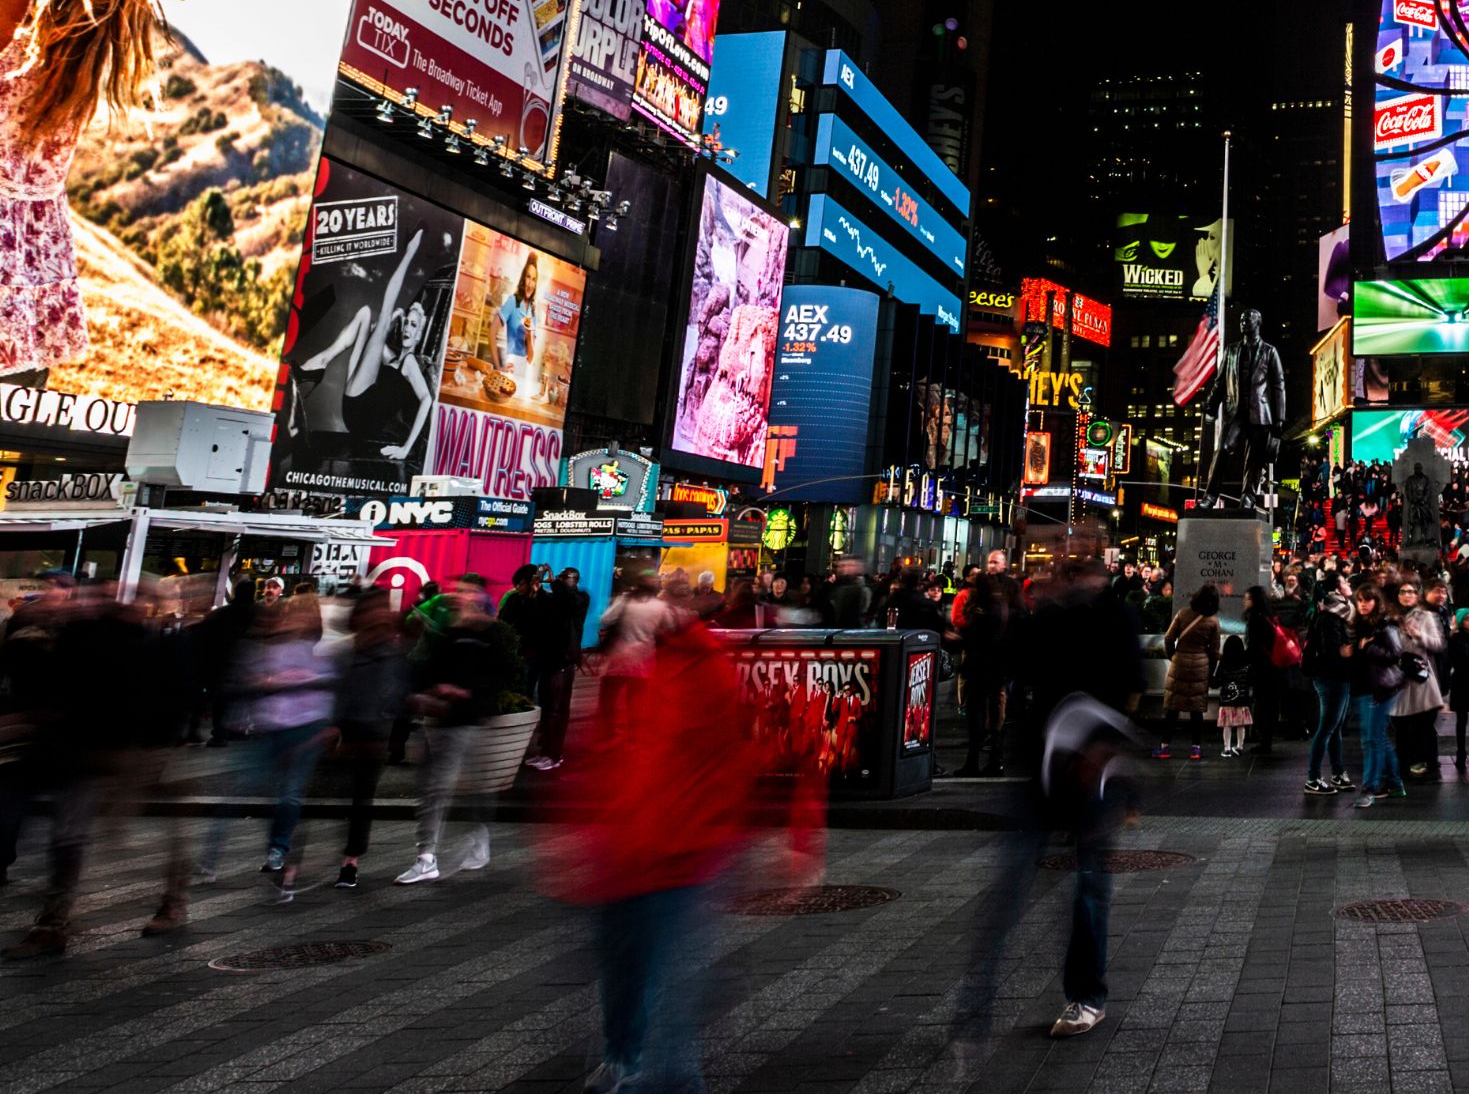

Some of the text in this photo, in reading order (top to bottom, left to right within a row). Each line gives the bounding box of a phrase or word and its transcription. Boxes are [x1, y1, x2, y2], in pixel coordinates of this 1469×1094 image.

[368, 6, 409, 42] TODAY
[1396, 2, 1435, 24] Coca-Cola
[374, 30, 395, 56] TIX
[573, 11, 640, 85] URPLE
[413, 48, 503, 116] The Broadway Ticket App
[572, 62, 615, 91] ON BROADWAY
[841, 64, 855, 90] AEX
[1377, 104, 1434, 137] Coca-Cola
[848, 145, 879, 191] 437.49
[893, 187, 918, 227] -1.32%
[317, 203, 395, 234] 20 YEARS
[531, 201, 563, 224] OUTFRONT
[319, 237, 392, 256] KILLING IT WORLDWIDE
[969, 290, 1015, 308] eese's
[785, 305, 829, 324] AEX
[784, 324, 851, 344] 437.49
[782, 342, 817, 352] -1.32%
[434, 406, 560, 501] WAITRESS
[6, 472, 118, 502] snackBOX
[286, 471, 407, 493] CHICAGOTHEMUSICAL.COM
[388, 501, 454, 524] NYC
[480, 500, 529, 514] The Official Guide
[543, 510, 587, 519] SnackBox
[556, 520, 611, 528] LOBSTER ROLLS
[687, 526, 720, 535] PAPAS
[1199, 551, 1236, 561] GEORGE
[1200, 569, 1234, 577] COHAN
[807, 660, 870, 706] BOYS
[909, 658, 932, 688] JERSEY
